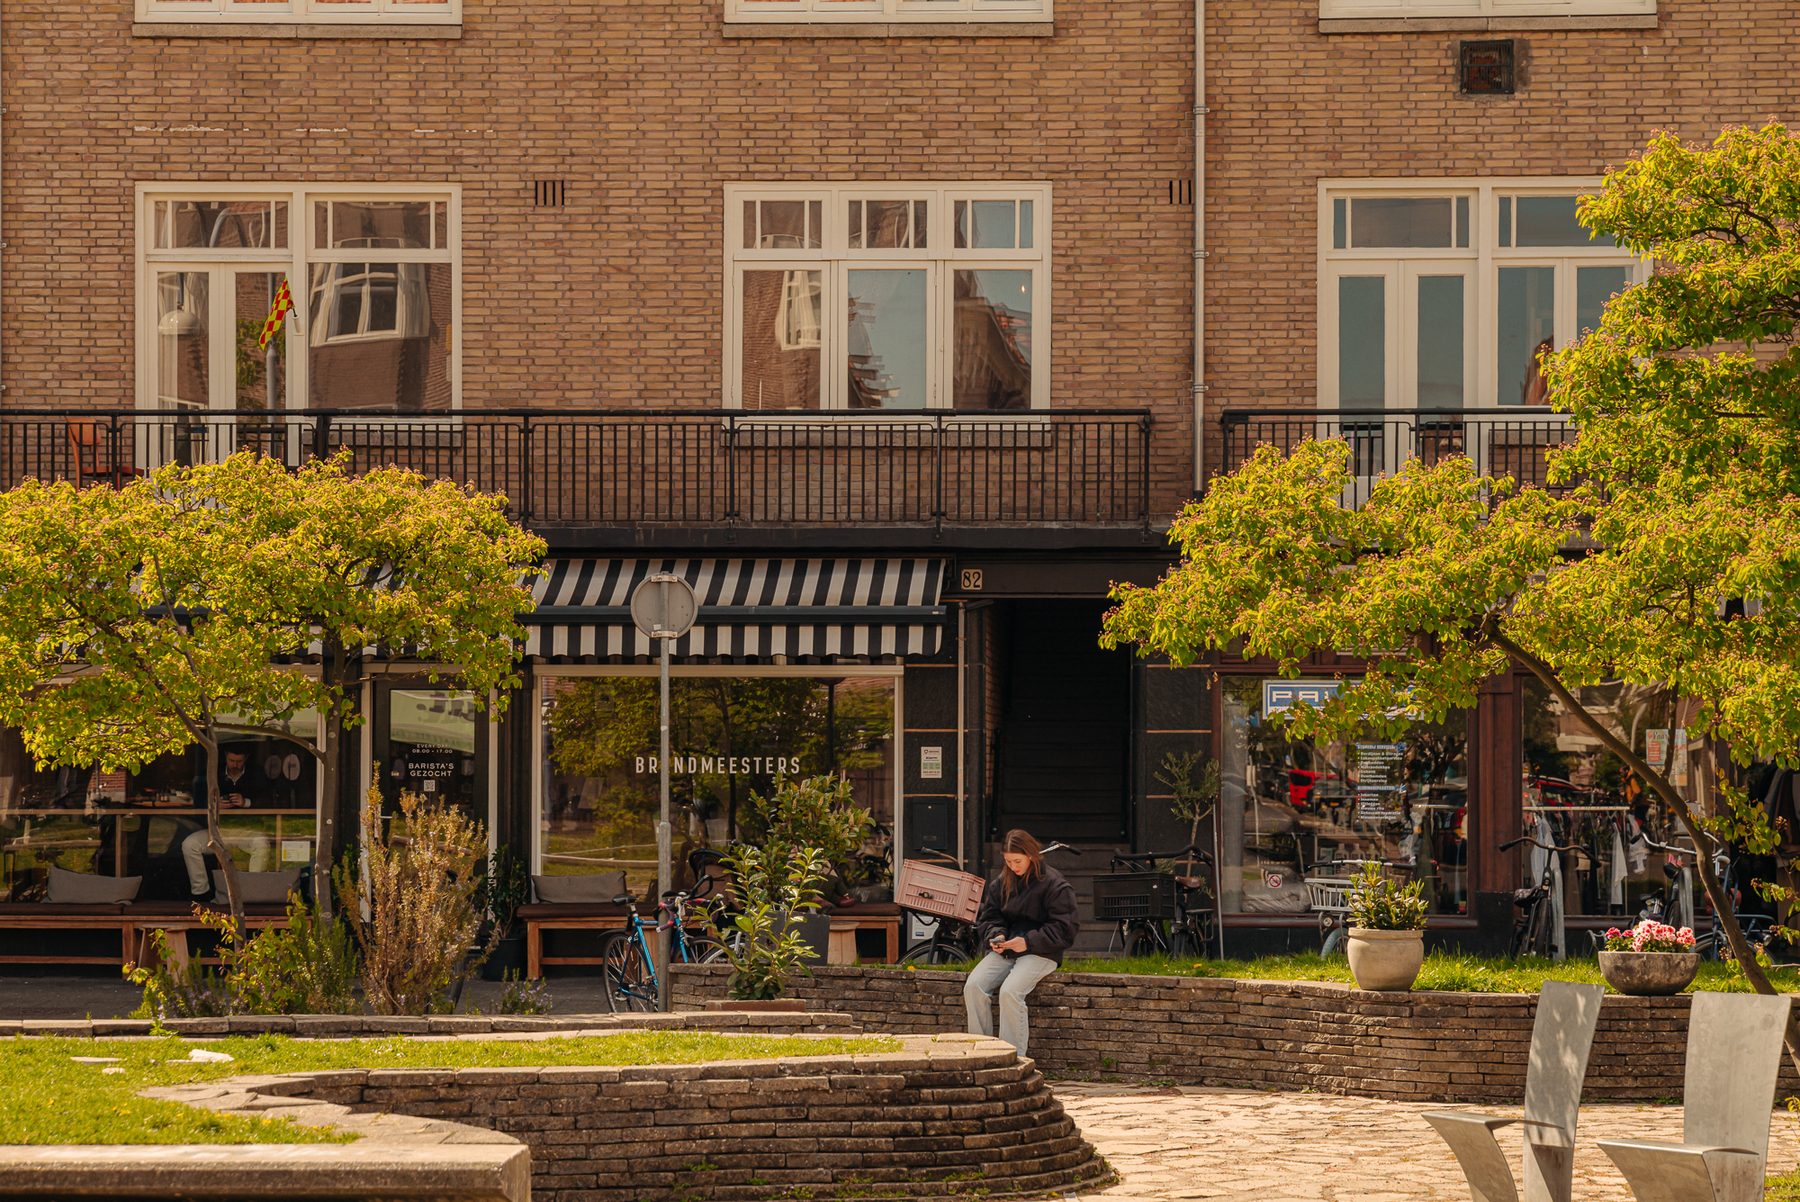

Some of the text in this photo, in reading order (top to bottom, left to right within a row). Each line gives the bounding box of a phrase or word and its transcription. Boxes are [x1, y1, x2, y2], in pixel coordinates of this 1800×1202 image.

[962, 571, 980, 588] 82
[408, 762, 454, 770] BARISTA'S
[635, 756, 800, 774] BRNDMEESTERS
